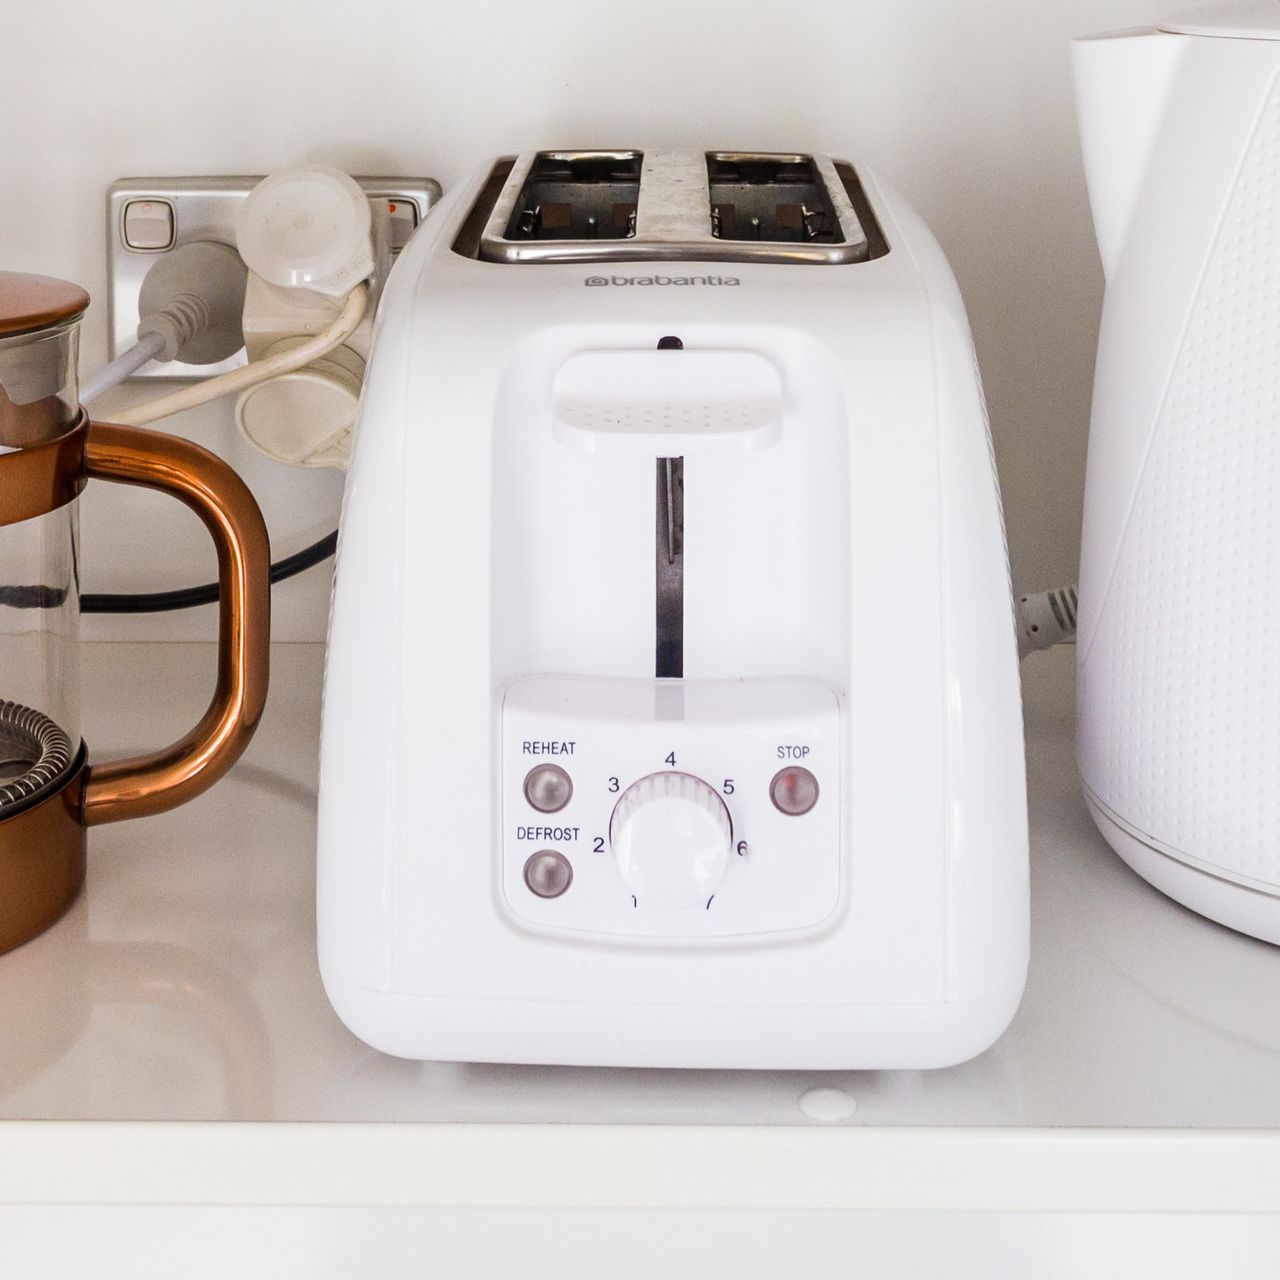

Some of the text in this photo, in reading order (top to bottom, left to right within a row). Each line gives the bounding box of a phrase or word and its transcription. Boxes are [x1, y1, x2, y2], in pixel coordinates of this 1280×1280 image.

[611, 274, 741, 287] brabantia
[522, 741, 576, 755] REHEAT
[776, 746, 810, 760] STOP
[664, 751, 677, 766] 4
[607, 777, 620, 792] 3
[723, 779, 735, 794] 5
[516, 826, 580, 841] DEFROST
[592, 836, 605, 853] 2
[736, 840, 749, 857] 6
